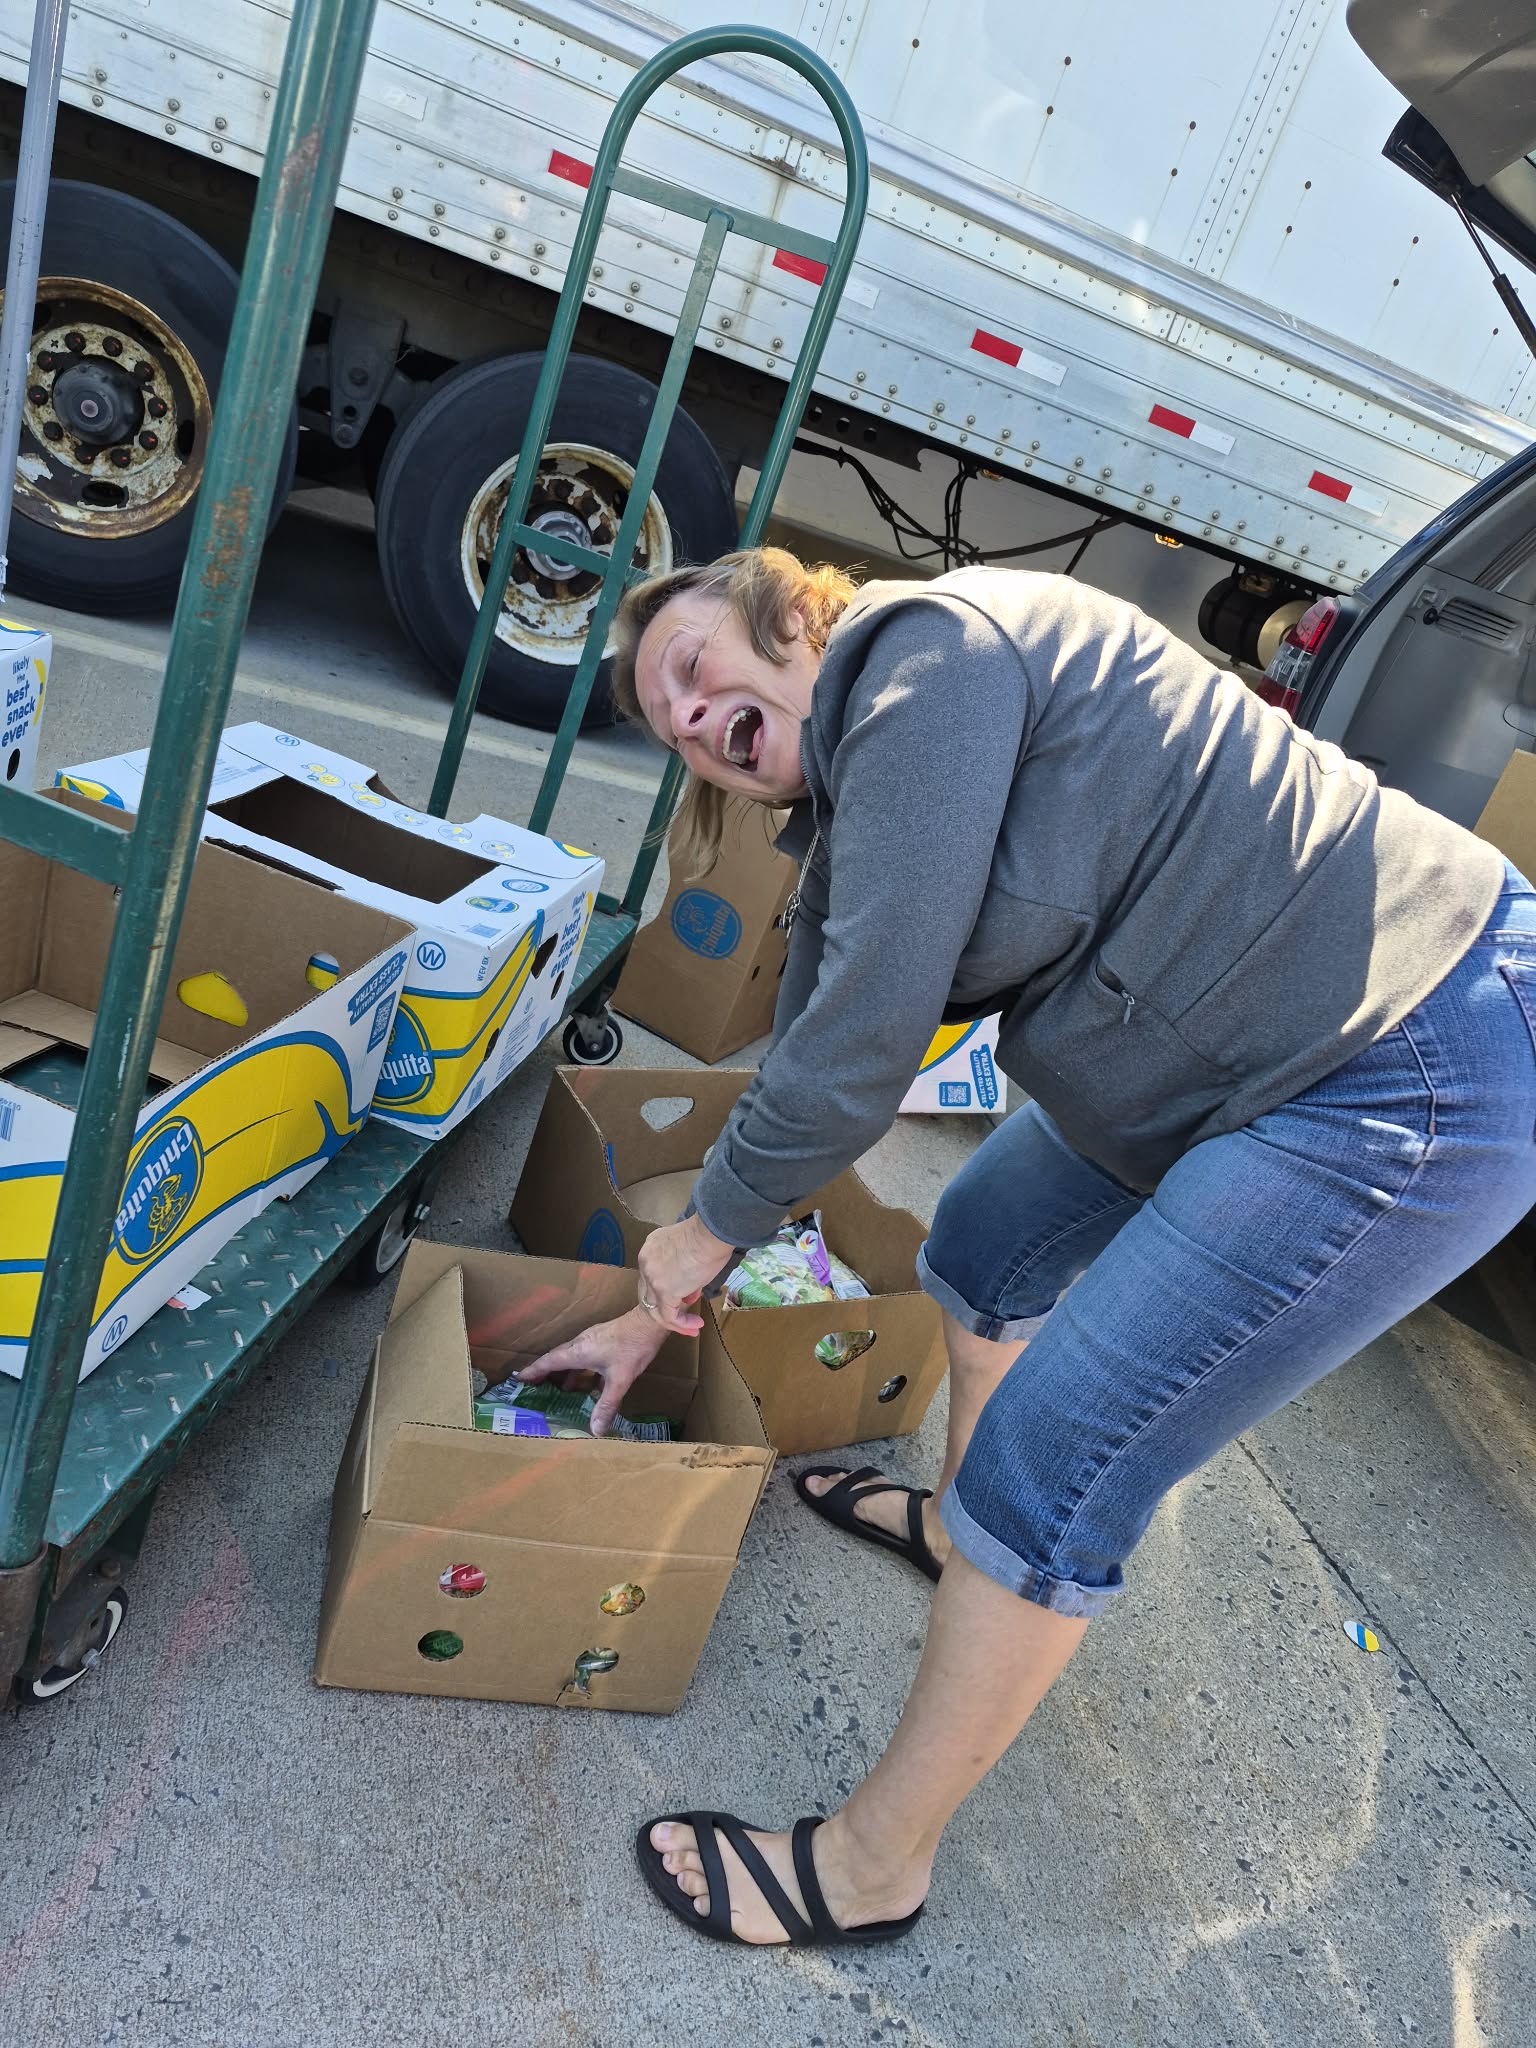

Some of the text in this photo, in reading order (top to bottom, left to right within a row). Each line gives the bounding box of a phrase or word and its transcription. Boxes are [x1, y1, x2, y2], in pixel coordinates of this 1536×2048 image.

[12, 656, 30, 675] likely
[17, 673, 26, 685] the
[6, 680, 30, 707] best
[7, 698, 36, 726] snack
[1, 720, 29, 747] ever
[550, 949, 573, 978] ever
[355, 956, 401, 1007] CLASS EXTRA
[973, 1052, 988, 1104] SELECTED QUALITY
[980, 1051, 996, 1100] CLASS EXTRA
[115, 1122, 194, 1233] Chiquita
